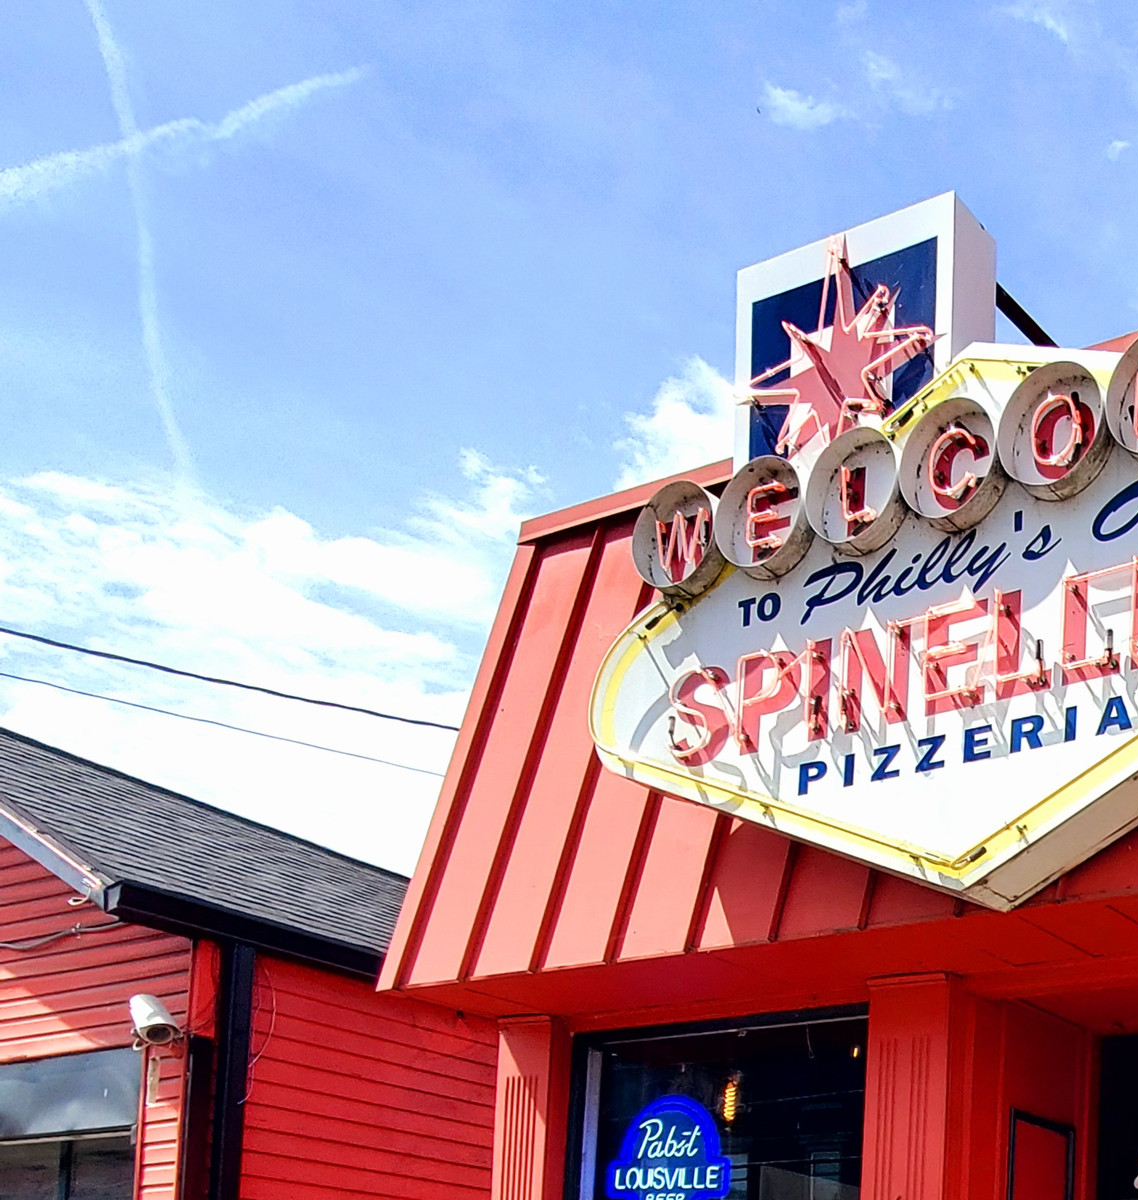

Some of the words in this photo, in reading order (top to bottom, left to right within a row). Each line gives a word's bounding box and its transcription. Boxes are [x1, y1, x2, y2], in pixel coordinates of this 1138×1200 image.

[738, 592, 782, 627] TO
[800, 510, 1062, 625] Philly's
[797, 696, 1134, 797] PIZZERIA
[637, 1119, 702, 1160] Pabst
[614, 1166, 721, 1191] LOUISVILLE
